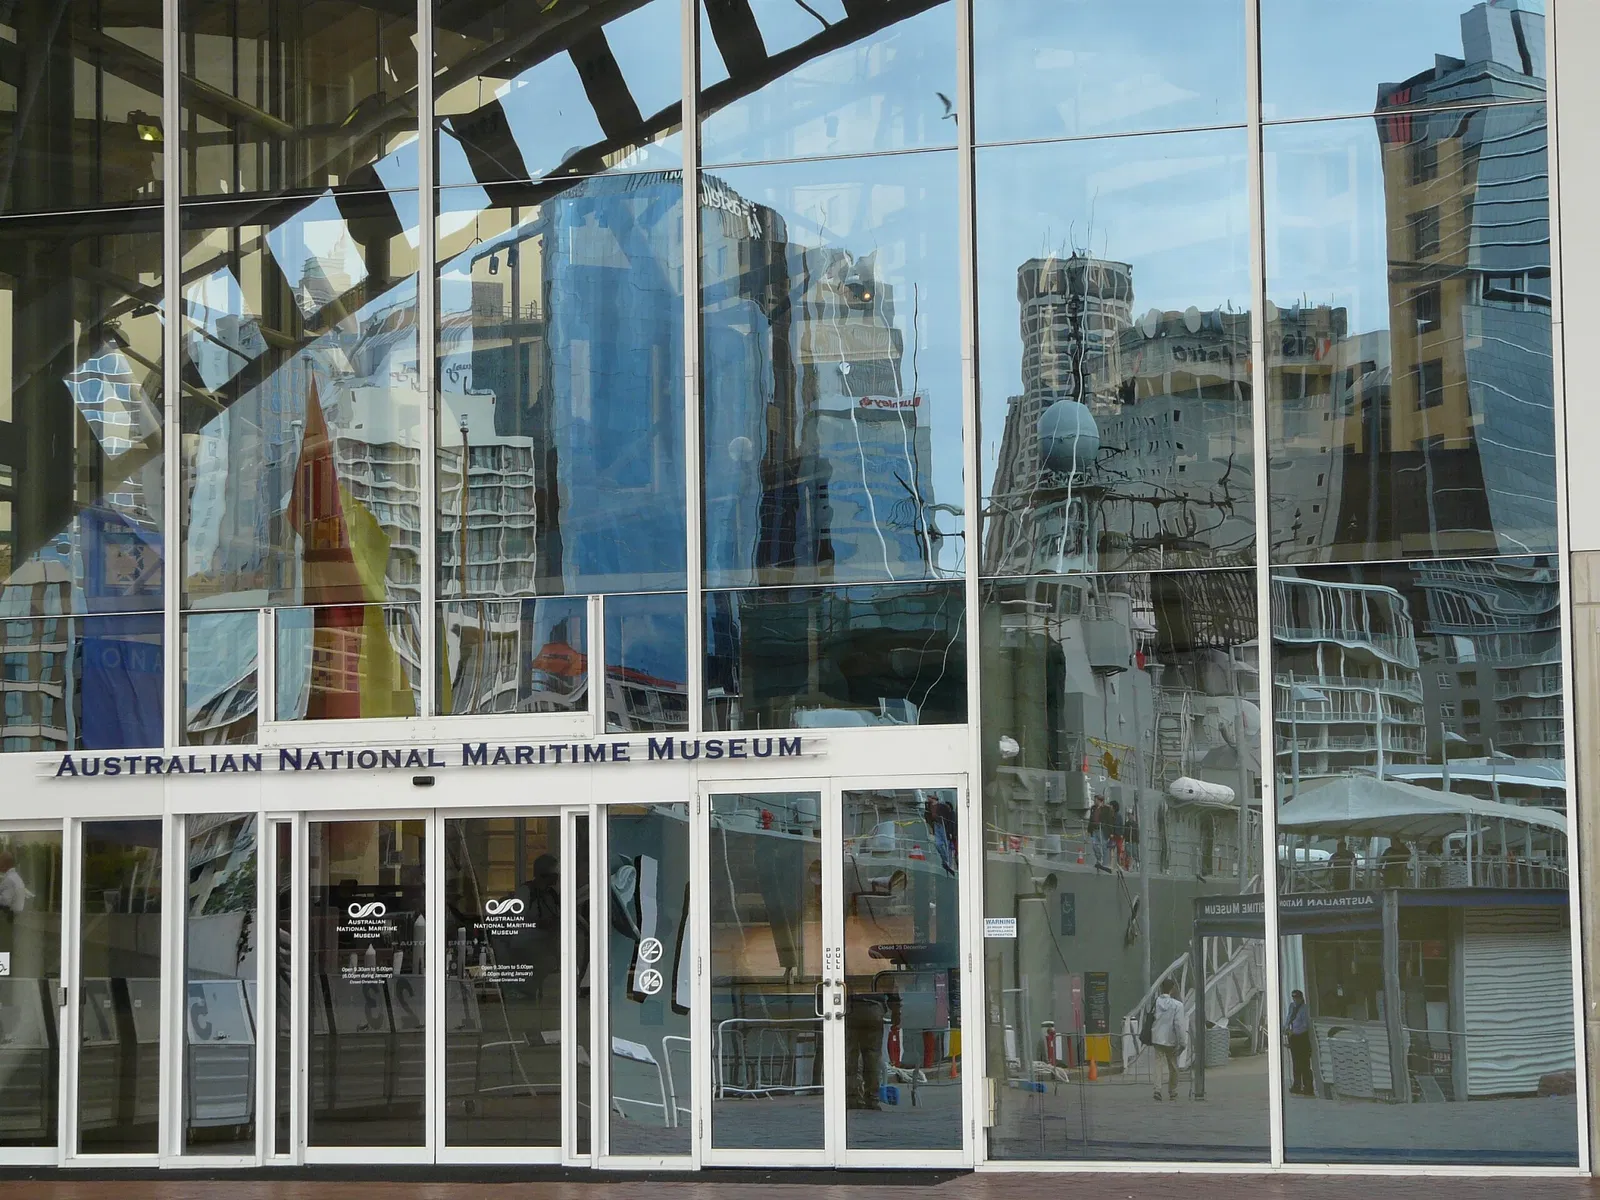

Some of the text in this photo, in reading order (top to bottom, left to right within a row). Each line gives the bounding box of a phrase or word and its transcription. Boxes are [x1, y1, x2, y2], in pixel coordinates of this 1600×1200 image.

[56, 736, 802, 777] AUSTRALIAN NATIONAL MARITIME MUSEUM
